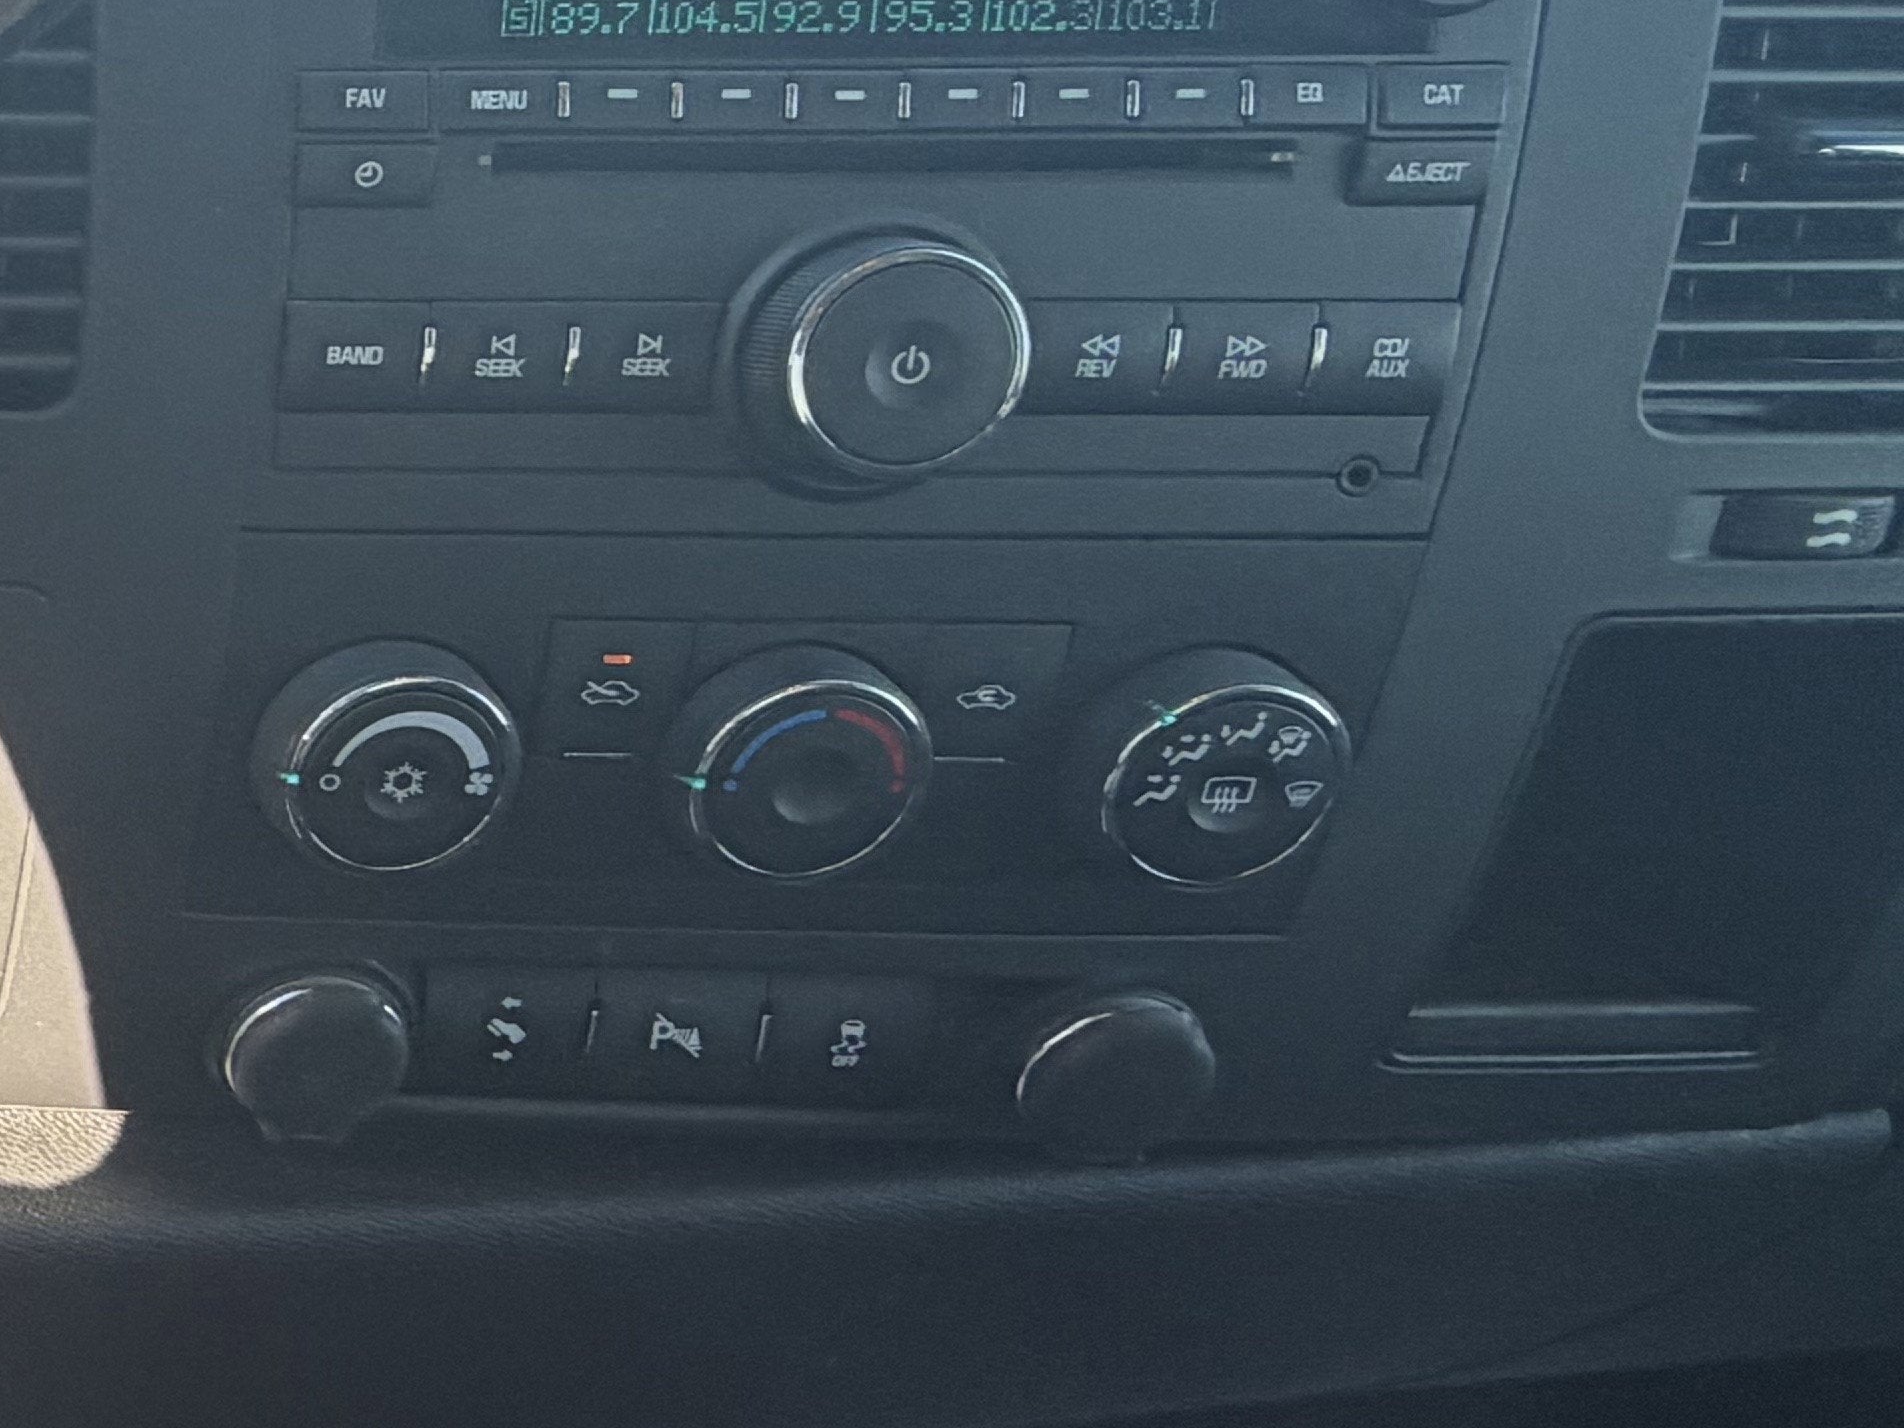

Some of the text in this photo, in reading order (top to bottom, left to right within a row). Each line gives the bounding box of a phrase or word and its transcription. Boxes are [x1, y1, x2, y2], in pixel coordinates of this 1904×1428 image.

[550, 2, 639, 35] 89.7
[655, 0, 758, 34] 104.5
[772, 0, 862, 34] 92.9
[885, 0, 974, 33] 95.3
[345, 87, 387, 109] FAV
[470, 89, 529, 111] MENU
[1296, 82, 1324, 105] EQ
[1423, 83, 1464, 107] CAT
[1404, 162, 1470, 183] EJECT
[326, 345, 384, 366] BAND
[475, 357, 524, 378] SEEK
[621, 357, 672, 378] SEEK
[1075, 358, 1117, 379] REV
[1217, 359, 1268, 380] FWD
[1366, 358, 1409, 378] AUX
